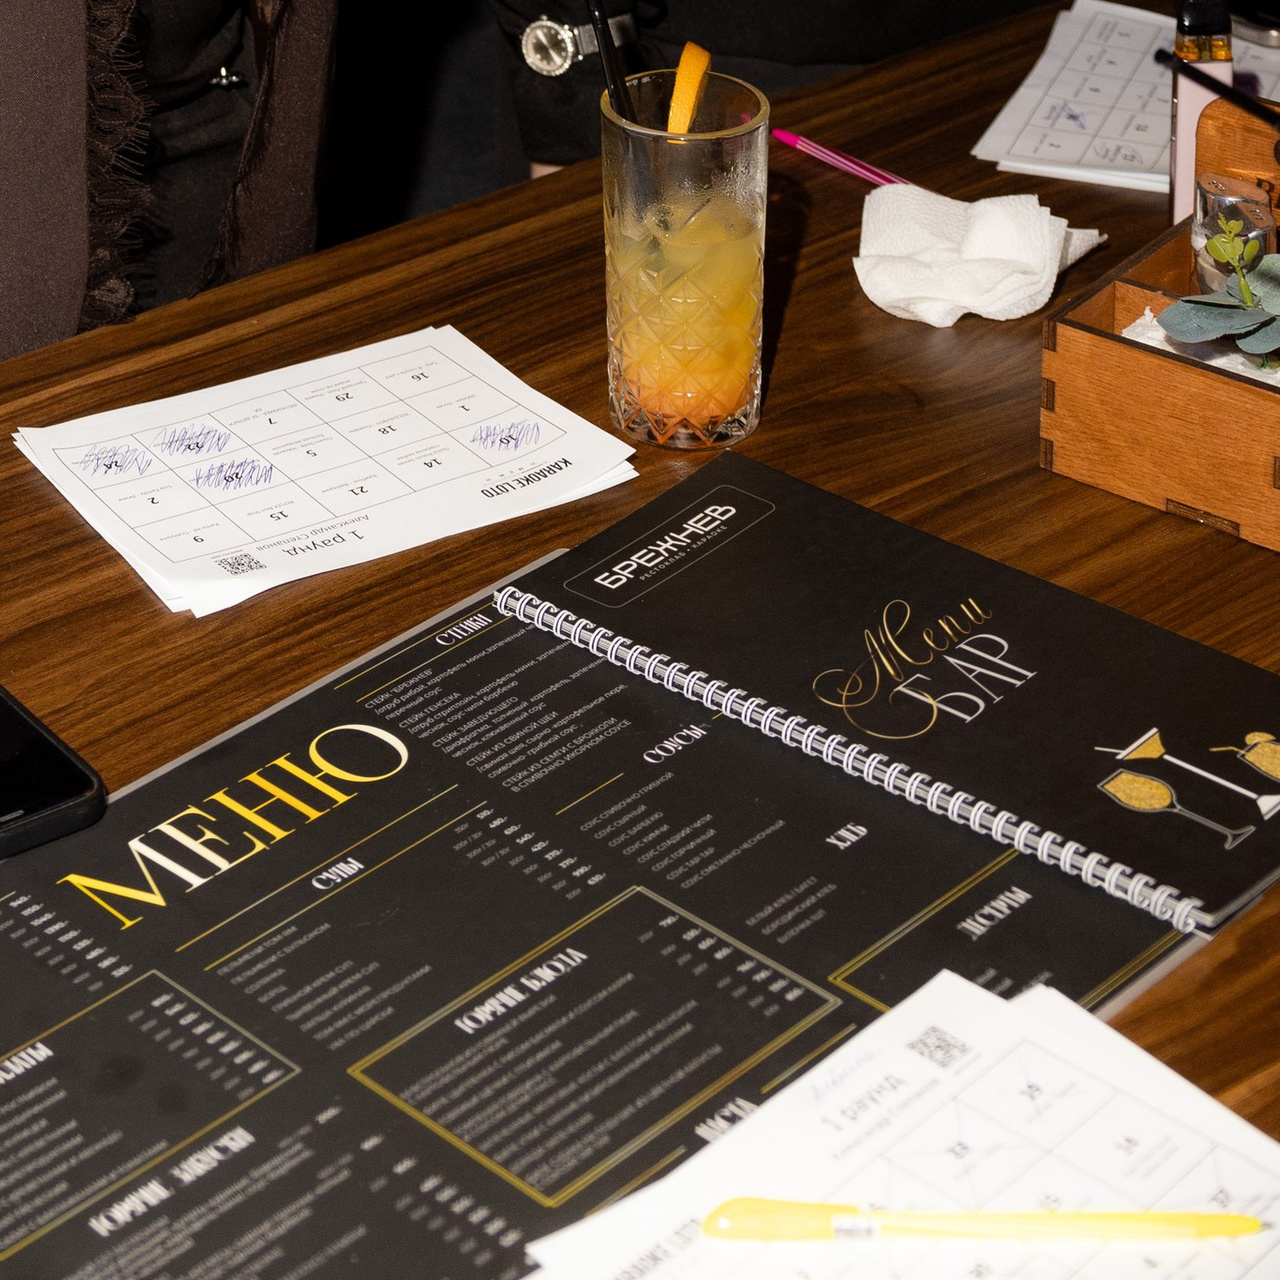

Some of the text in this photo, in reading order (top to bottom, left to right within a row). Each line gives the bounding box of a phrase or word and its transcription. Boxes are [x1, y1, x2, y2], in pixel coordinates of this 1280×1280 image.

[409, 370, 430, 382] 16
[332, 390, 354, 402] 29
[264, 416, 277, 425] 7
[376, 423, 398, 435] 18
[304, 448, 317, 457] 5
[497, 433, 517, 445] 10
[422, 457, 443, 469] 14
[481, 456, 572, 500] KARAOKE LOTO
[146, 496, 159, 505] 2
[347, 484, 369, 497] 21
[267, 509, 289, 522] 15
[190, 534, 205, 544] 9
[253, 511, 371, 552] Александр Степанов
[282, 529, 365, 559] 1 раунд
[592, 501, 740, 589] БРЕЖНЕВ
[638, 525, 729, 580] РЕСТОКЛАБ КАРАОКЕ
[430, 612, 494, 646] СТЕЙКИ
[424, 661, 468, 685] картофель
[473, 671, 516, 695] картофель
[813, 597, 993, 739] Menu
[893, 633, 1037, 723] БАР
[362, 668, 436, 708] СТЕЙК "БРЕЖНЕВ"
[383, 686, 443, 720] перечный соус
[527, 677, 572, 702] картофель,
[396, 691, 462, 728] СТЕЙК ГЕНСЕКА
[416, 680, 520, 739] чеснок, соус чили барбекю
[430, 696, 520, 747] СТЕЙК ЗАВЕДУЮЩЕГО
[450, 701, 548, 758] чеснок, клюквенный соус
[464, 710, 560, 766] СТЕЙК ИЗ СВИНОЙ ШЕИ
[523, 727, 553, 744] сырно
[524, 734, 562, 755] грибной
[556, 723, 579, 736] соус
[602, 719, 632, 736] СОУСЕ
[500, 769, 531, 787] СТЕЙК
[526, 762, 542, 771] ИЗ
[538, 746, 569, 764] СЕМГИ
[571, 717, 618, 744] БРОККОЛИ
[638, 724, 709, 765] СОУСЫ
[578, 816, 602, 831] СОУС
[637, 771, 675, 794] ГРИБНОЙ
[55, 724, 409, 931] МЕНЮ
[592, 804, 648, 839] СОУС СЫРНЫЙ
[822, 821, 872, 850] ХЛЕБ
[606, 832, 631, 847] СОУС
[621, 840, 645, 855] СОУС
[635, 848, 660, 863] СОУС
[649, 856, 674, 871] СОУС
[306, 856, 366, 892] СУПЫ
[517, 945, 591, 992] БЛЮДА
